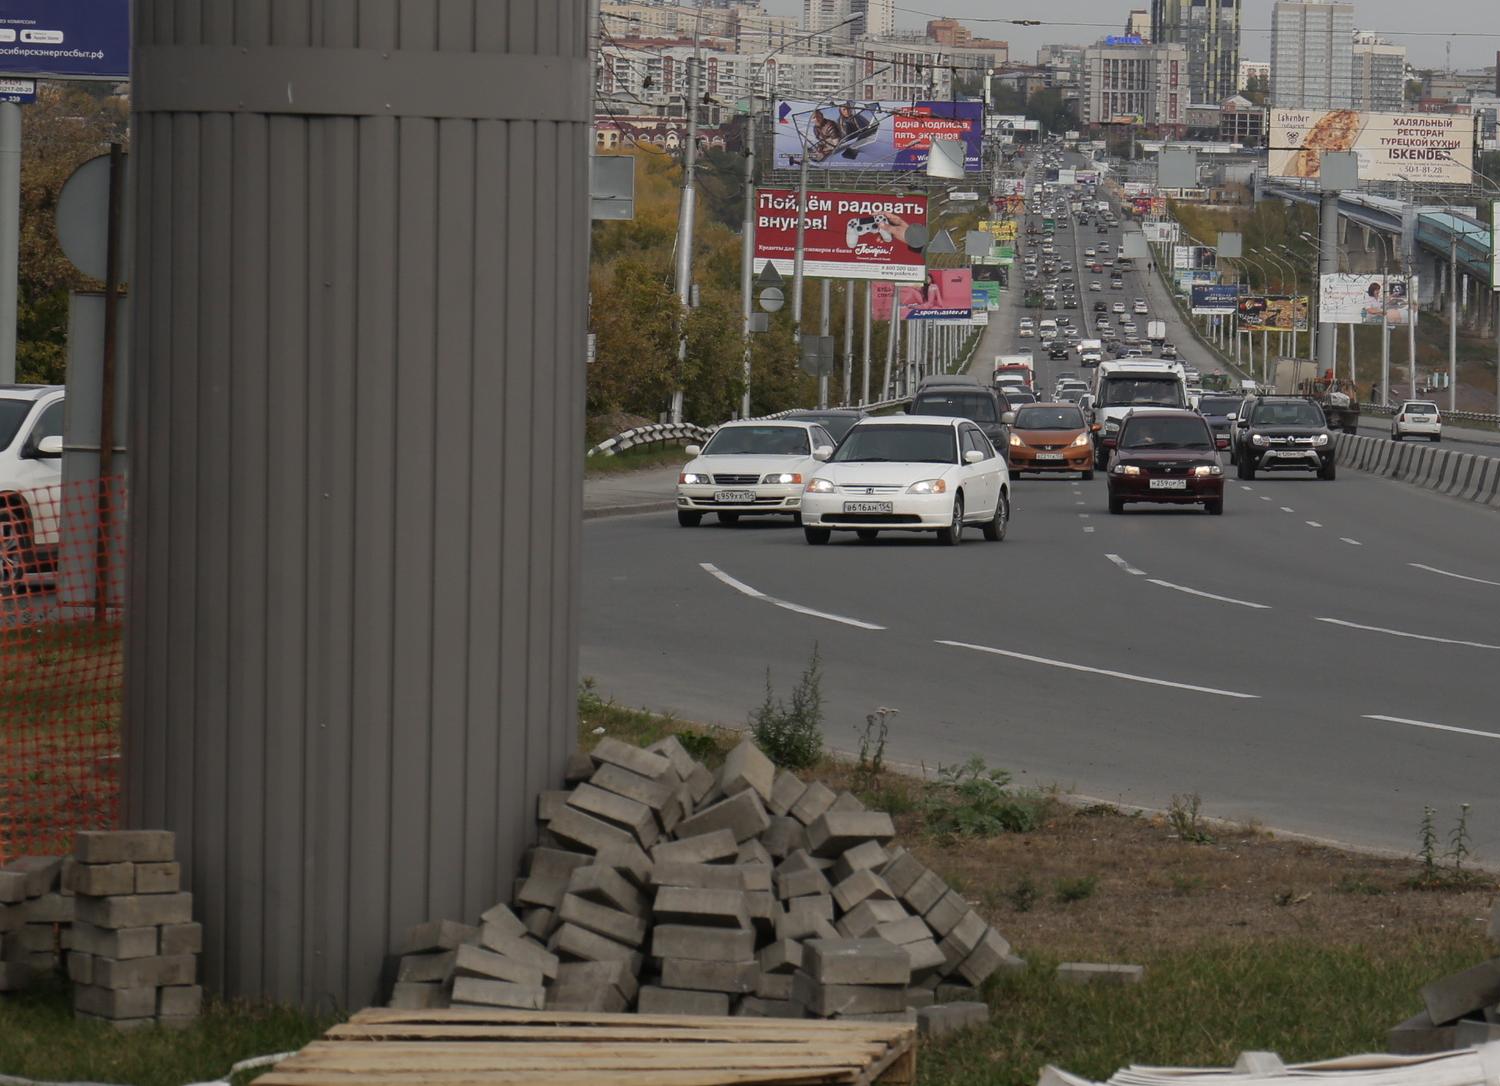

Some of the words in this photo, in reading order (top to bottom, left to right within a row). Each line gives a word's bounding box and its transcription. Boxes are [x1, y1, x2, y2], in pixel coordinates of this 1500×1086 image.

[895, 121, 919, 130] одна
[1393, 118, 1453, 128] ХАЛЯЛЬНЫЙ
[894, 132, 916, 140] пять
[1397, 128, 1444, 138] РЕСТОРАН
[1380, 137, 1429, 148] ТУРЕЦКОЙ
[1429, 139, 1461, 149] КУХНИ
[1388, 149, 1451, 161] ISKENDER
[759, 194, 832, 213] Пойём
[838, 200, 924, 215] радовать
